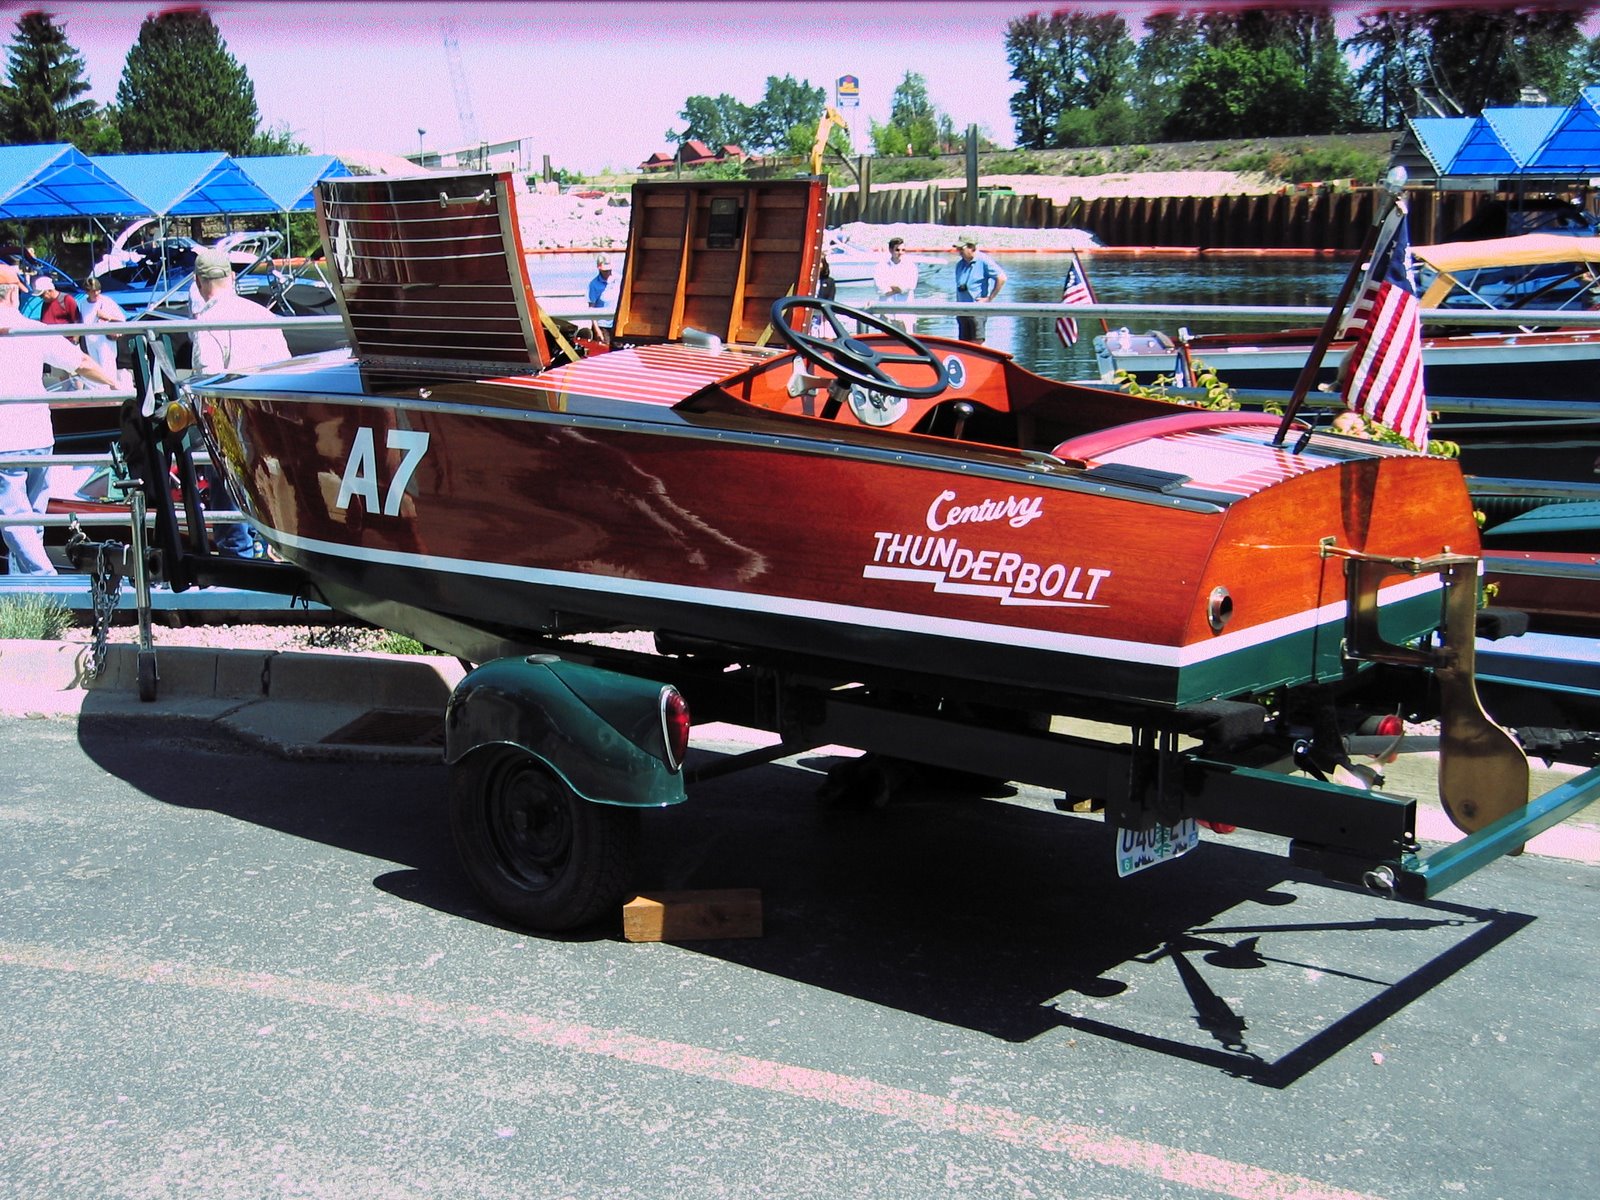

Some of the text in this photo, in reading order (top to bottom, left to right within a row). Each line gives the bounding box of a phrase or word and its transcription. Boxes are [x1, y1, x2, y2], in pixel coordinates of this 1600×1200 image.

[336, 426, 430, 517] A7
[926, 489, 1043, 532] Century
[873, 531, 1112, 601] THUNDERBOLT
